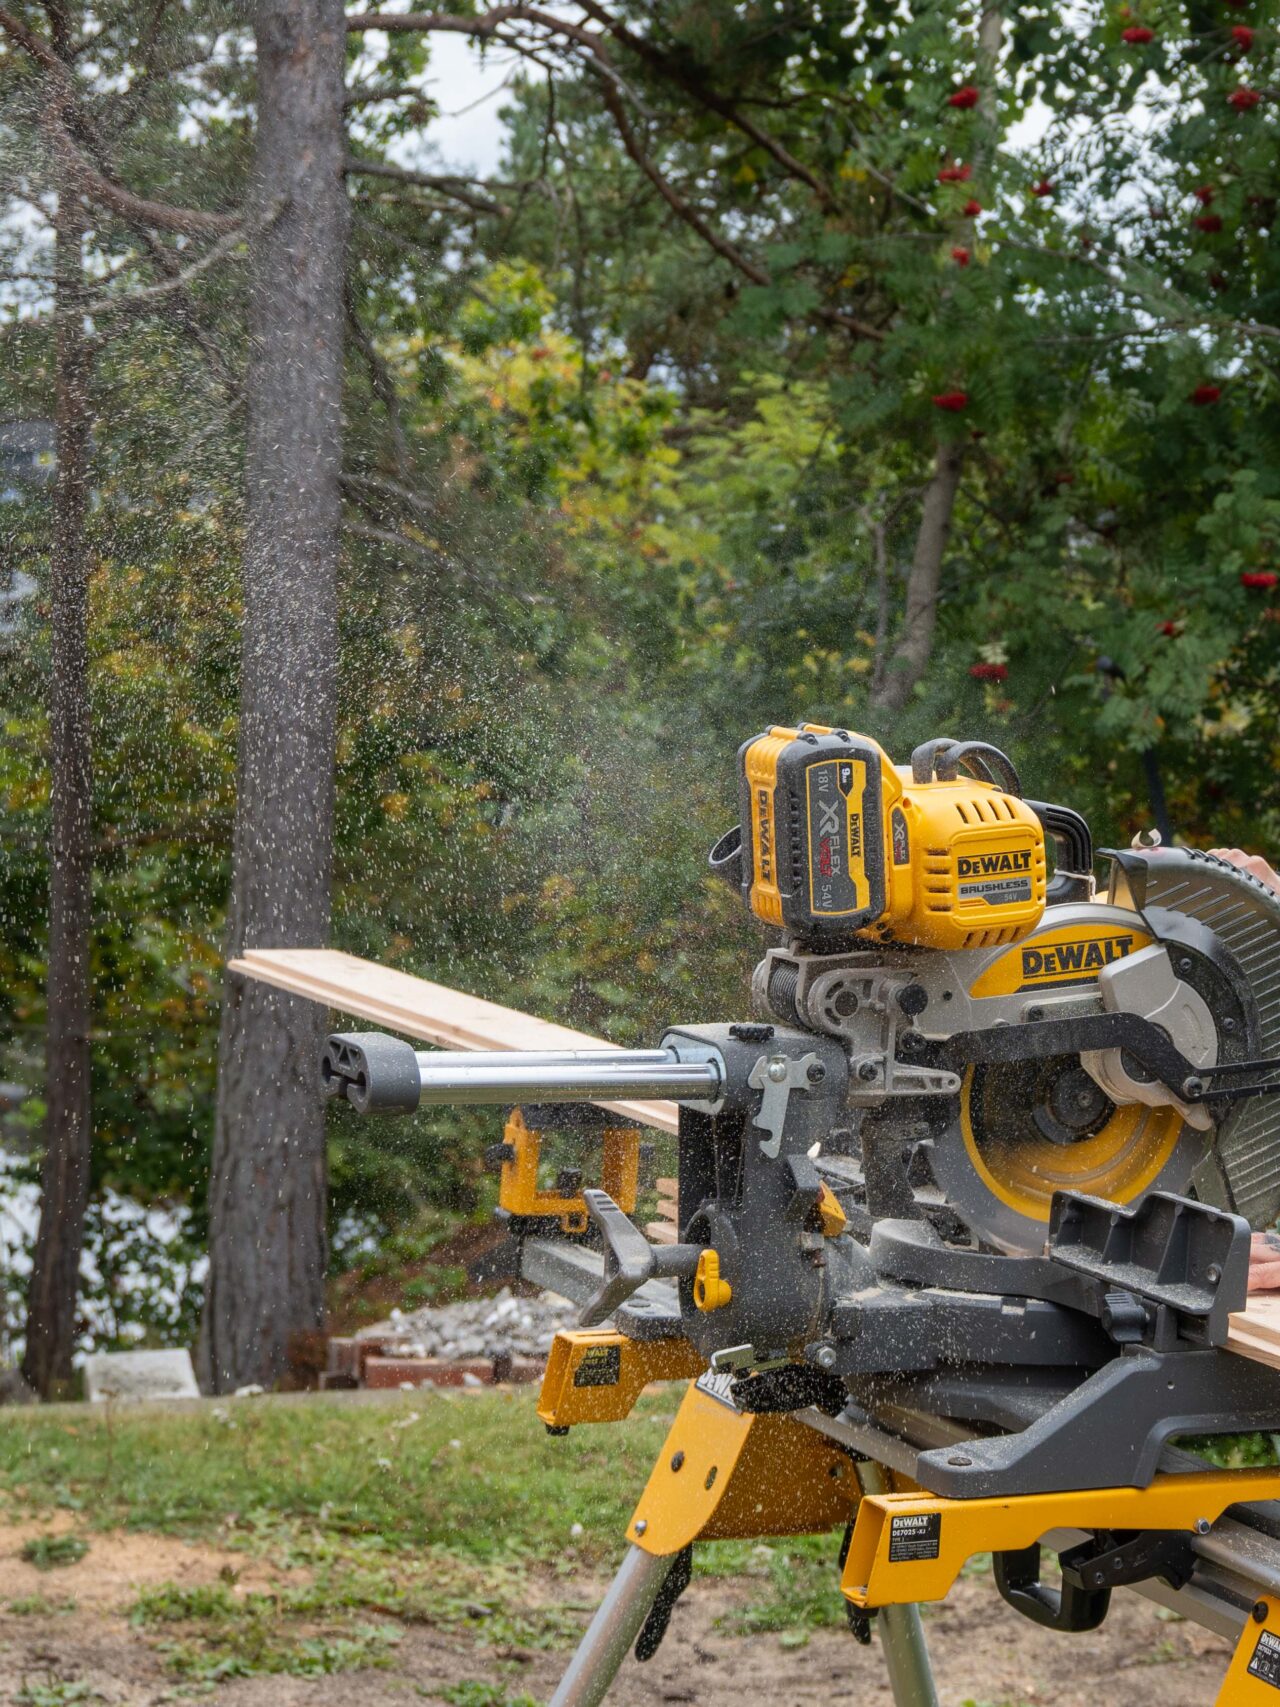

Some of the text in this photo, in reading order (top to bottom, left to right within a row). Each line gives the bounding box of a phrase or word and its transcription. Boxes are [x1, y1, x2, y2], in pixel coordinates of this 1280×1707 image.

[817, 770, 829, 793] 18V
[818, 800, 840, 836] XR
[850, 813, 861, 857] DEWALT
[819, 838, 833, 878] VOLT
[830, 835, 841, 875] FLEX
[957, 851, 1031, 877] DEWALT
[821, 884, 833, 908] 54V
[960, 879, 1028, 895] BRUSHLESS
[1022, 937, 1133, 976] DEWALT
[893, 1517, 928, 1528] DEWALT
